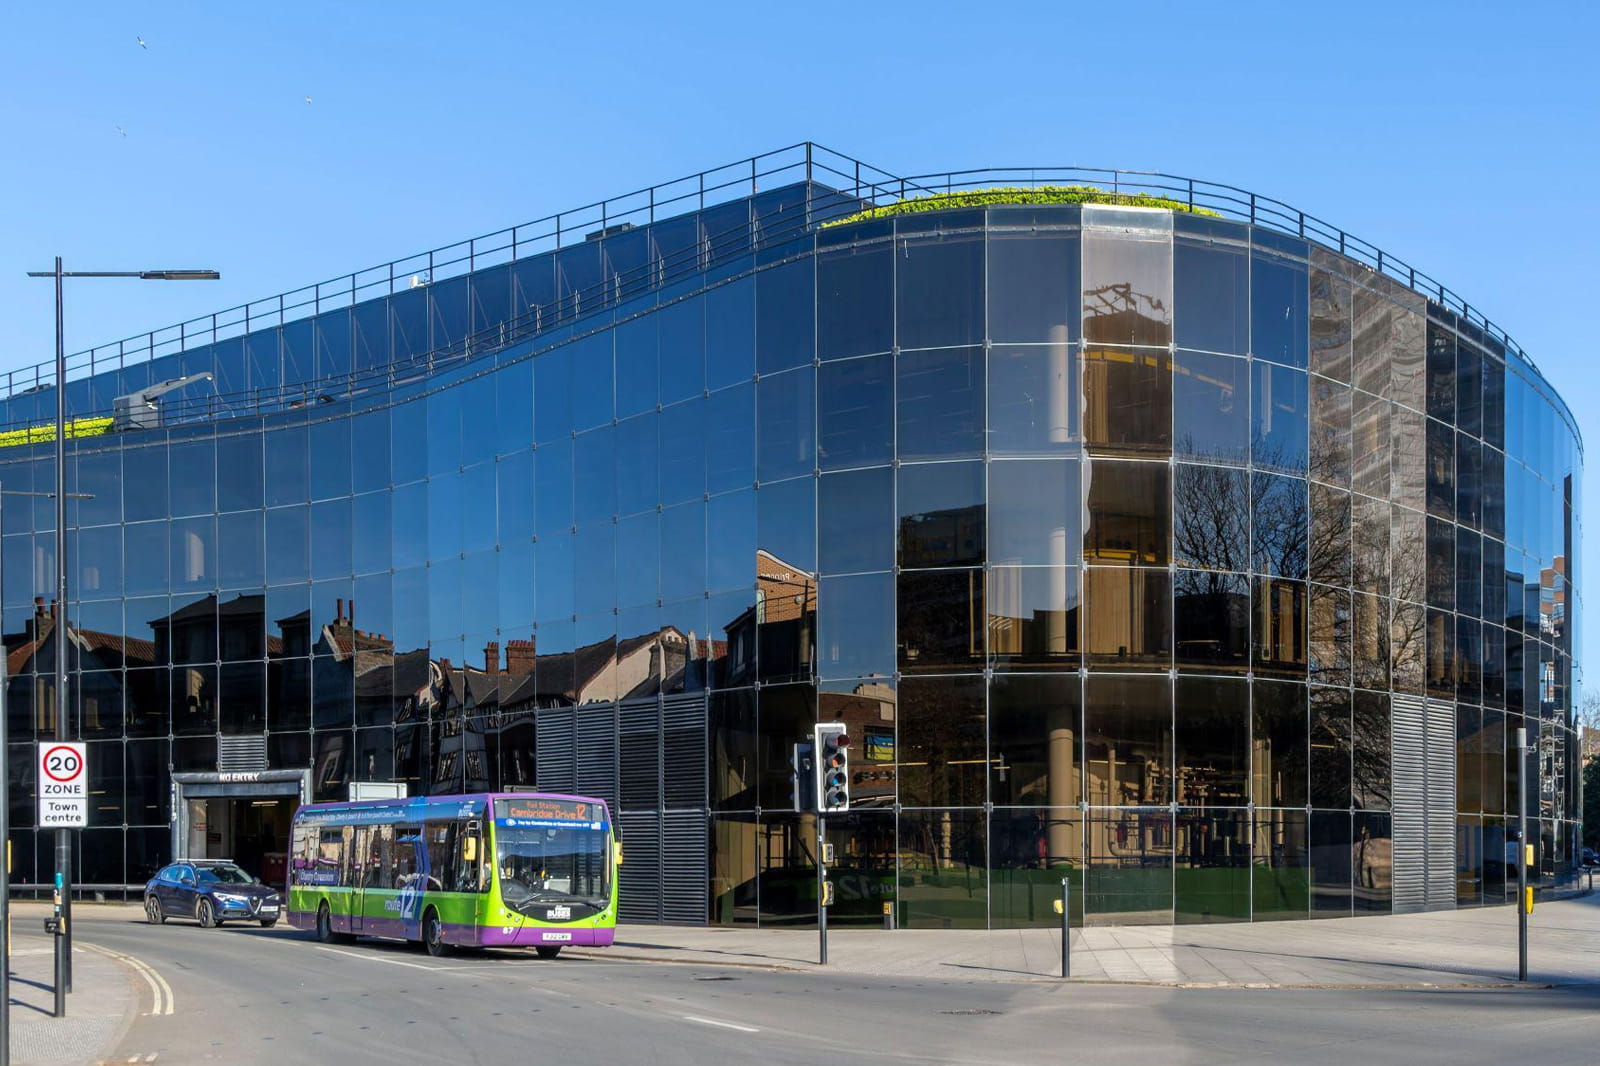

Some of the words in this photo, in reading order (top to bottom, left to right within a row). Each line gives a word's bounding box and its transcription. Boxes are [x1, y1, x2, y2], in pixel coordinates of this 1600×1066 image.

[50, 757, 77, 771] 20
[219, 773, 231, 782] NO
[232, 772, 260, 781] ENTRY
[45, 785, 81, 794] ZONE
[48, 802, 78, 811] Town
[576, 803, 586, 819] 12
[45, 814, 82, 822] centre
[510, 807, 553, 818] Cambridge
[555, 811, 576, 819] Drive
[384, 898, 401, 911] route
[400, 886, 415, 919] 12
